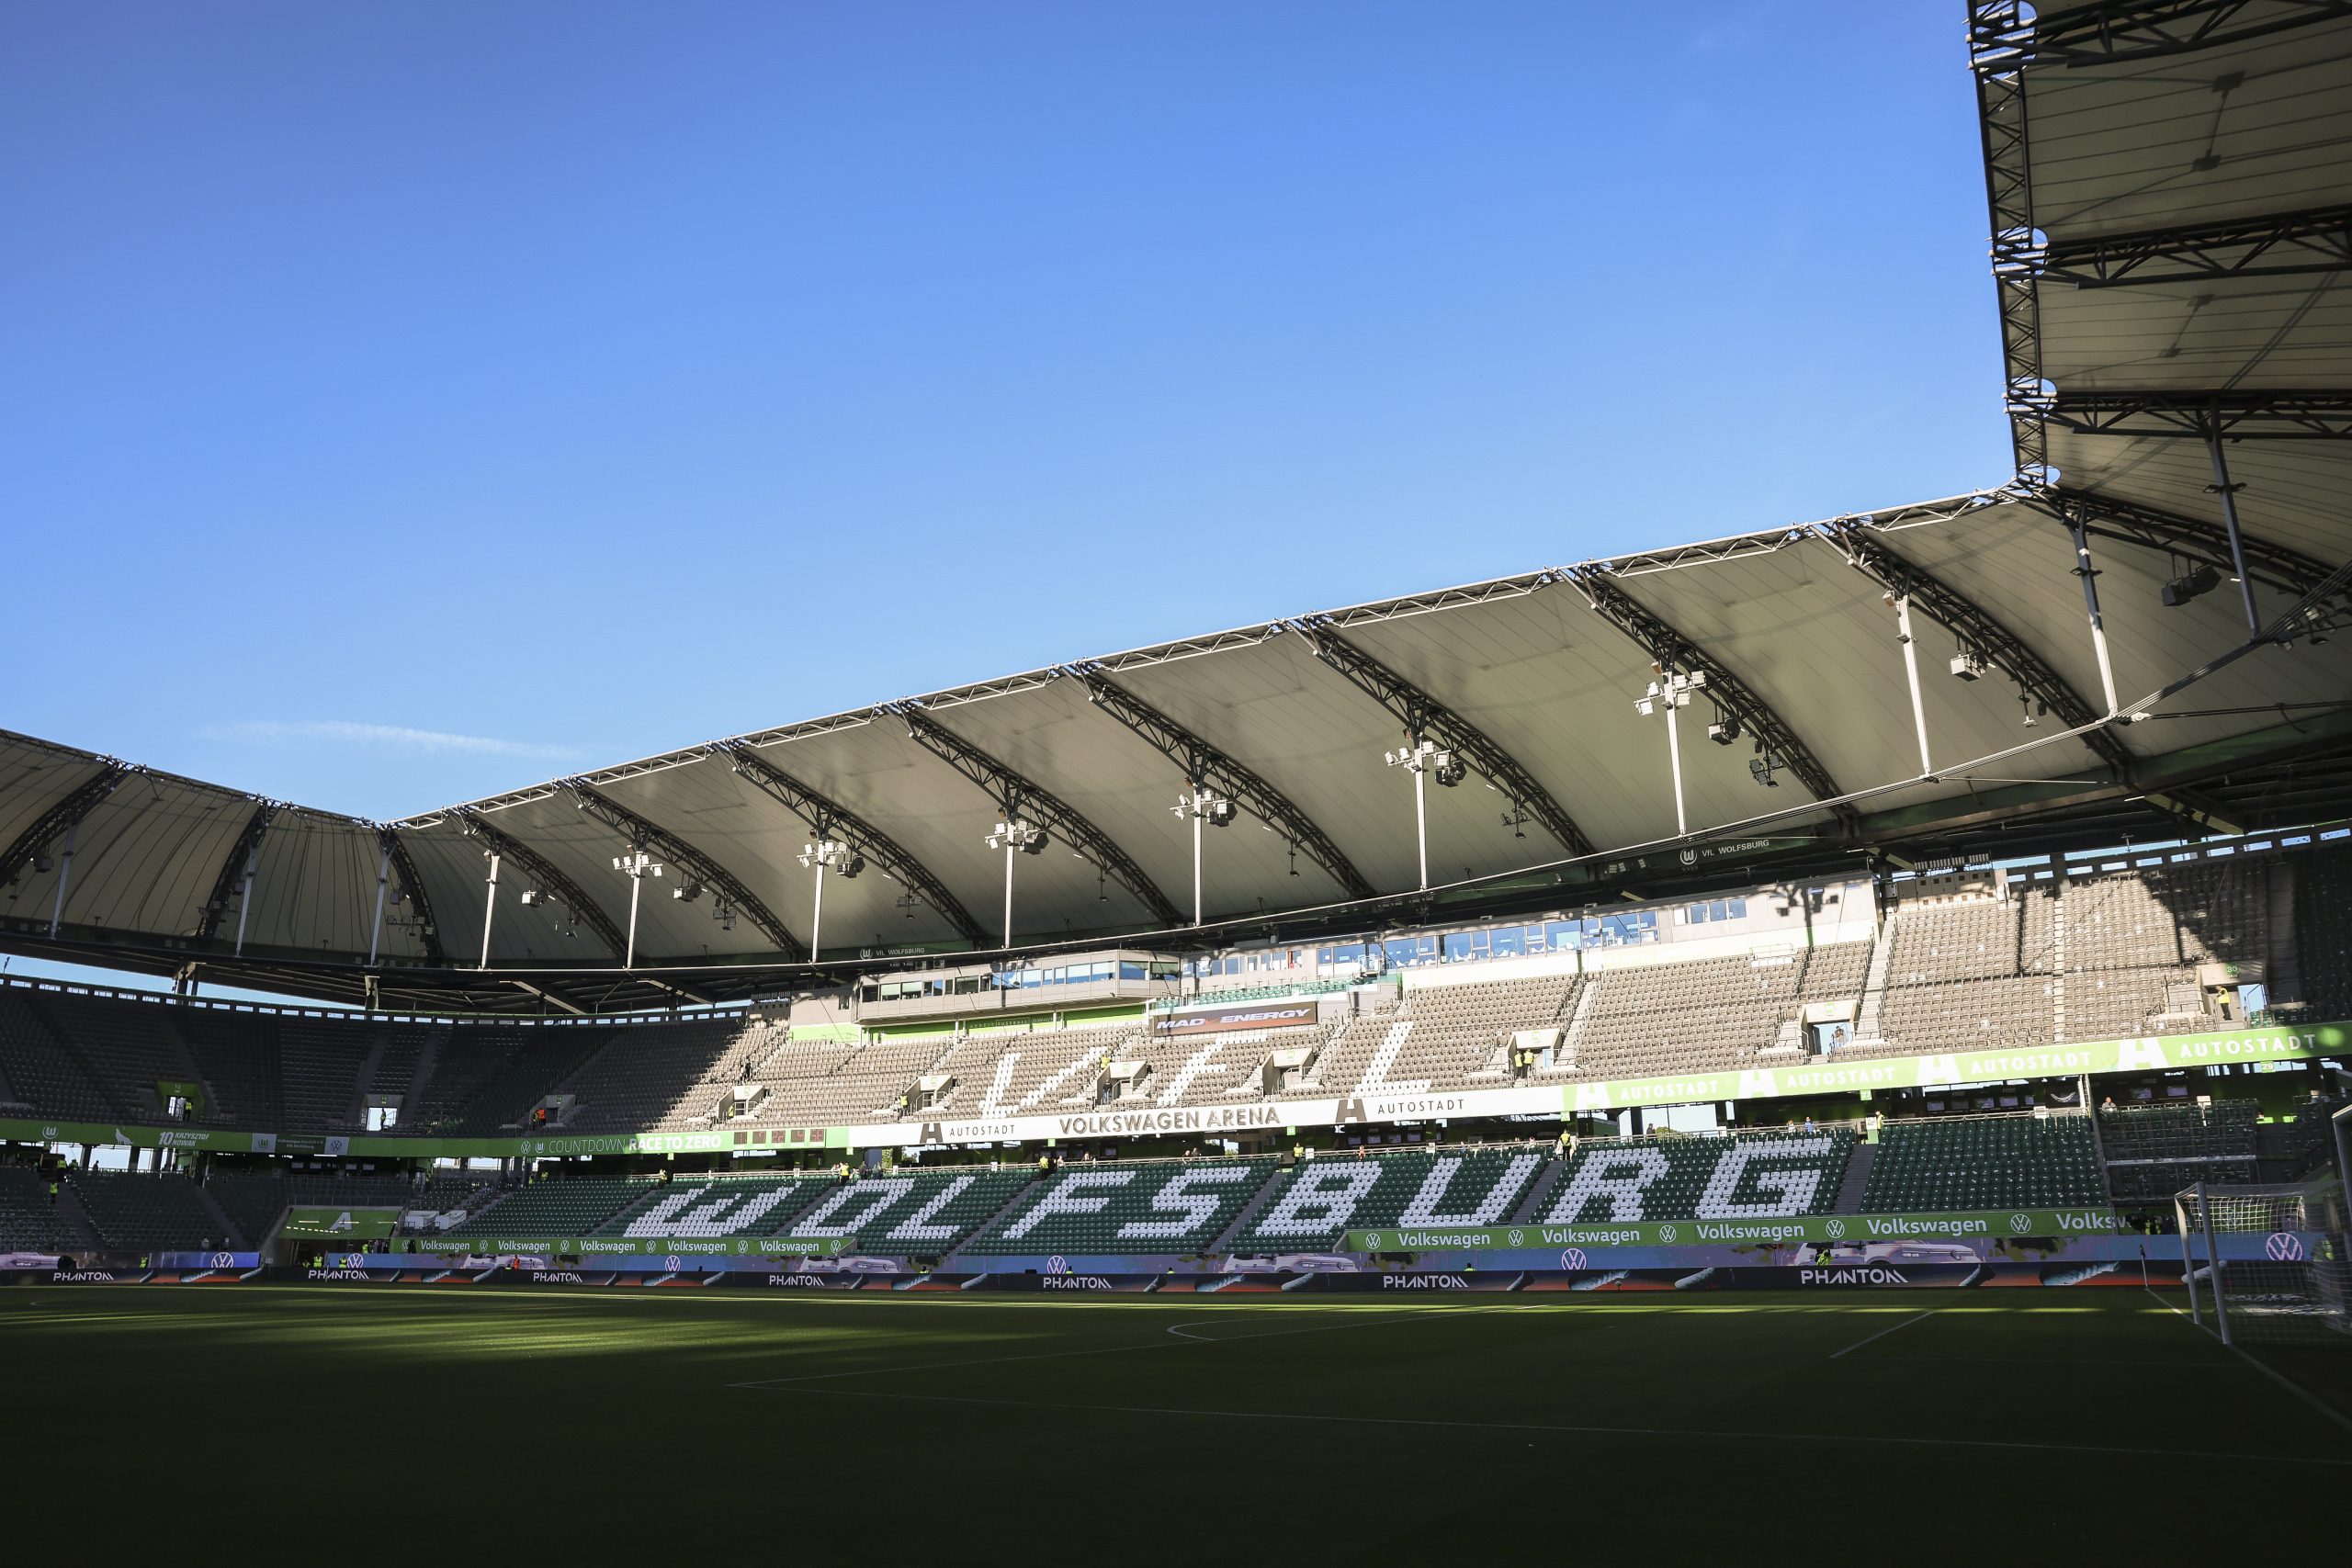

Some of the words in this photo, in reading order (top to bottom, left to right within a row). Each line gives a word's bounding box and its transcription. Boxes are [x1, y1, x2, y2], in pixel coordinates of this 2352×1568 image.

[1718, 839, 1770, 855] WOLFSBURG
[888, 947, 925, 955] WOLFSBURG
[1156, 1018, 1205, 1030] MAD
[1219, 1008, 1312, 1024] ENERGY
[2179, 1033, 2316, 1060] AUTOSTADT
[1971, 1051, 2093, 1076] AUTOSTADT
[2262, 1063, 2274, 1071] 29
[1787, 1066, 1895, 1089] AUTOSTADT
[1620, 1080, 1719, 1101] AUTOSTADT
[1377, 1098, 1464, 1115] AUTOSTADT
[1058, 1111, 1200, 1135] VOLKSWAGEN
[1207, 1105, 1281, 1128] ARENA
[949, 1123, 1016, 1137] AUTOSTADT
[158, 1131, 175, 1145] 10
[175, 1132, 209, 1140] KRZYSZTOF
[173, 1139, 197, 1147] NOWAK
[548, 1137, 626, 1154] COUNTDOWN
[628, 1137, 662, 1151] RACE
[665, 1136, 684, 1150] TO
[685, 1134, 721, 1149] ZERO
[1696, 1224, 1804, 1241] Volkswagen
[1867, 1217, 1987, 1236] Volkswagen
[1398, 1232, 1491, 1249] Volkswagen
[1543, 1229, 1640, 1247] Volkswagen
[421, 1240, 469, 1252] Volkswagen
[498, 1240, 550, 1253] Volkswagen
[580, 1240, 636, 1253] Volkswagen
[667, 1241, 727, 1254] Volkswagen
[760, 1241, 820, 1254] Volkswagen
[53, 1272, 114, 1282] PHANTOM
[309, 1269, 369, 1280] PHANTOM
[533, 1272, 582, 1283] PHANTOM
[769, 1275, 825, 1286] PHANTOM
[1801, 1269, 1909, 1284] PHANTOM
[1044, 1277, 1114, 1289] PHANTOM
[1384, 1275, 1468, 1289] PHANTOM
